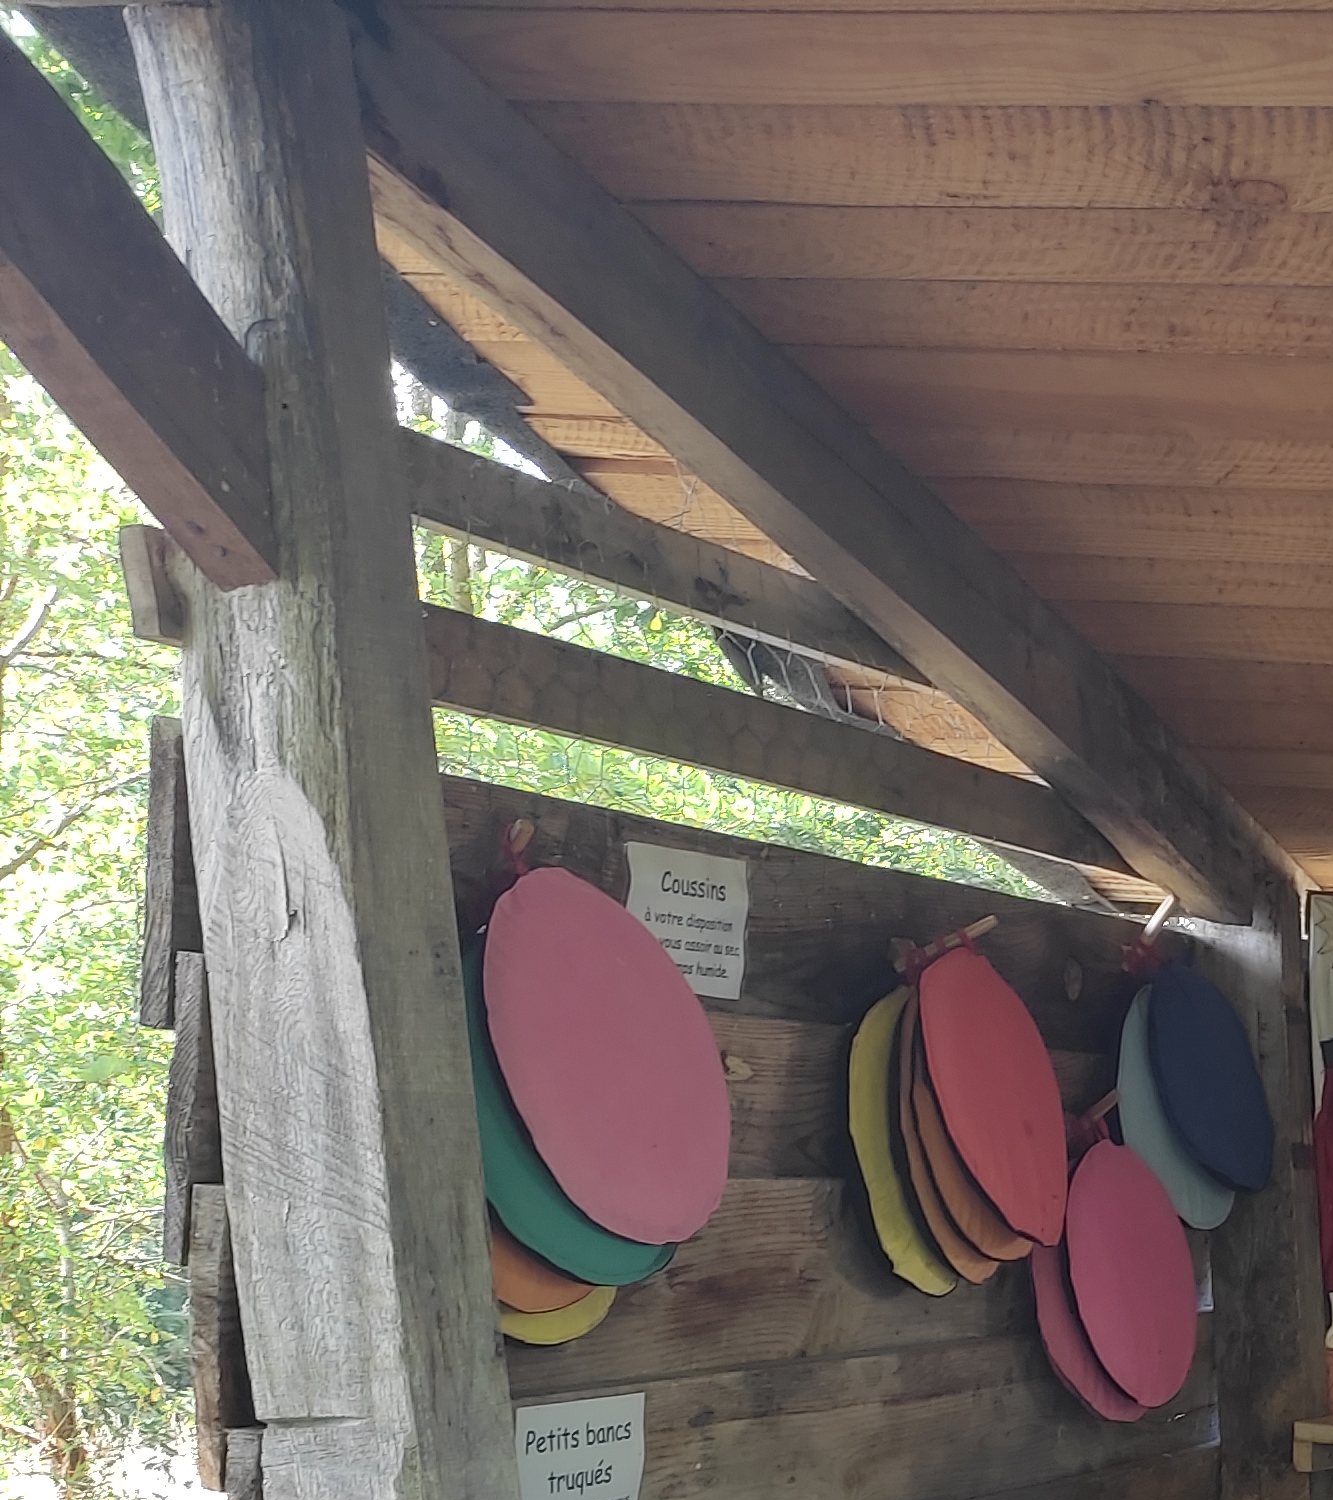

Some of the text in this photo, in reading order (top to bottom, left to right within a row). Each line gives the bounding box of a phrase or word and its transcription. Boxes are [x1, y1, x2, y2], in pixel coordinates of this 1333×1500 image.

[661, 871, 727, 901] Coussins
[654, 912, 683, 926] votre
[686, 913, 733, 932] disposition
[525, 1421, 632, 1455] Petits bancs
[547, 1459, 613, 1495] truqués
